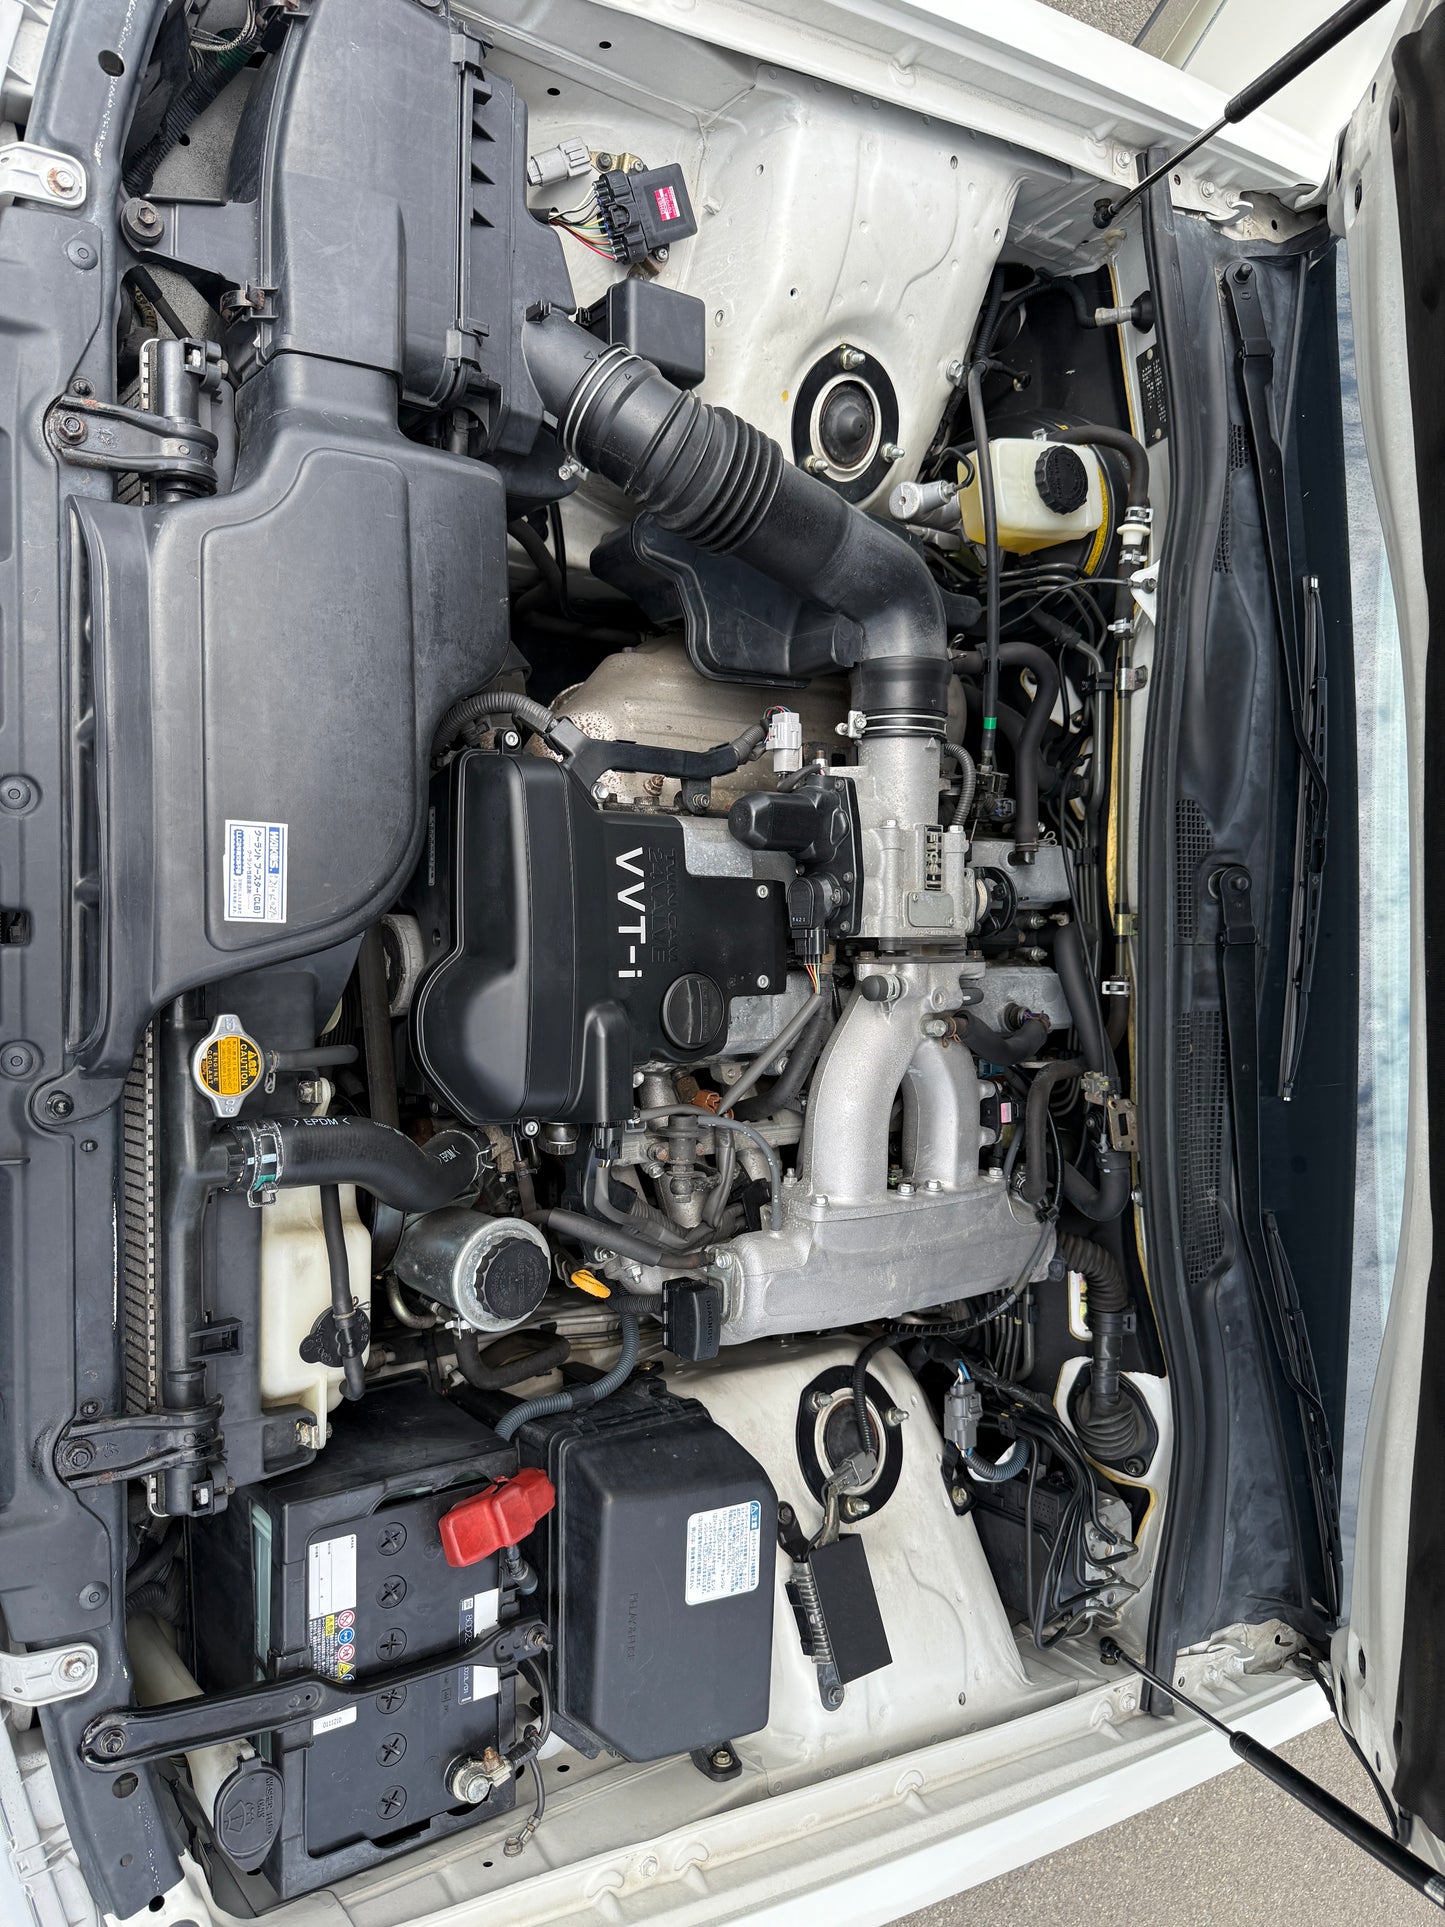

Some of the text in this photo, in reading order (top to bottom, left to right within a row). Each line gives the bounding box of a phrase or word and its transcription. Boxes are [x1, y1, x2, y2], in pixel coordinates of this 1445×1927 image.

[253, 830, 262, 860] クーラント
[615, 847, 646, 978] VVT-i
[240, 1043, 248, 1086] CAUTION
[304, 1117, 339, 1126] EPDM
[265, 1776, 274, 1809] WASHER
